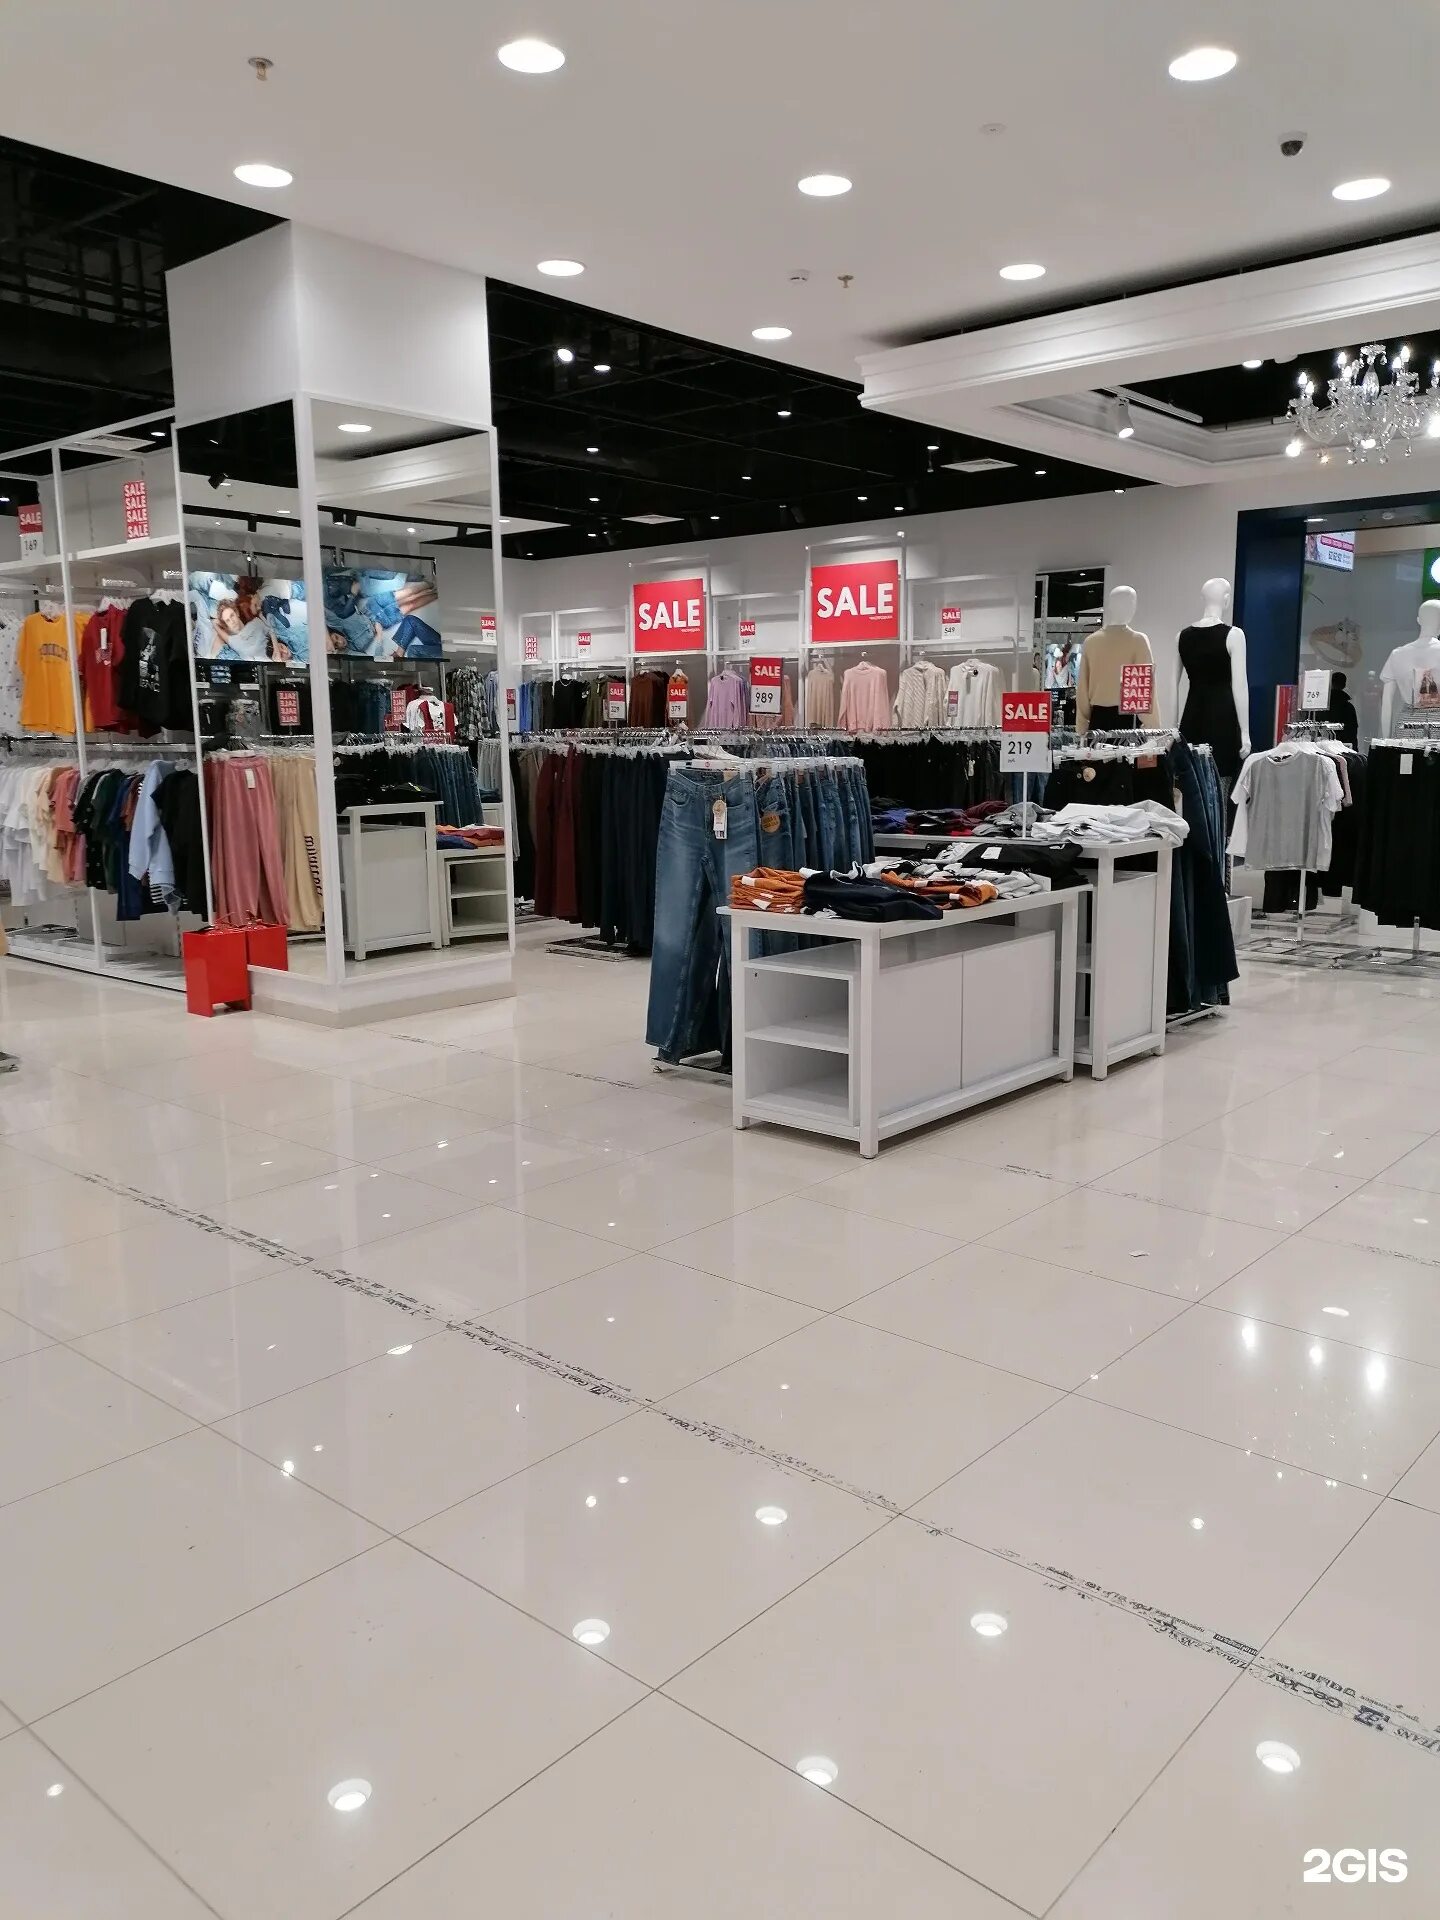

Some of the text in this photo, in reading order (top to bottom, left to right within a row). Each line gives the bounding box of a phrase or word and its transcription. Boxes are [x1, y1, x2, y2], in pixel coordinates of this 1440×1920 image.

[124, 482, 146, 496] SALE
[125, 496, 147, 509] SALE
[20, 511, 42, 525] SALE
[126, 508, 148, 523] SALE
[127, 523, 149, 538] SALE
[24, 540, 37, 551] 169
[817, 583, 894, 619] SALE
[638, 599, 701, 631] SALE
[942, 611, 961, 620] SALE
[740, 624, 756, 632] SALE
[754, 665, 781, 677] SALE
[1124, 666, 1151, 676] SALE
[1123, 677, 1150, 687] SALE
[610, 688, 624, 696] SALE
[670, 688, 686, 696] SALE
[755, 692, 773, 703] 989
[1123, 688, 1150, 698] SALE
[1306, 691, 1320, 699] 769
[1122, 700, 1149, 710] SALE
[1004, 703, 1048, 720] SALE
[1008, 741, 1032, 754] 219
